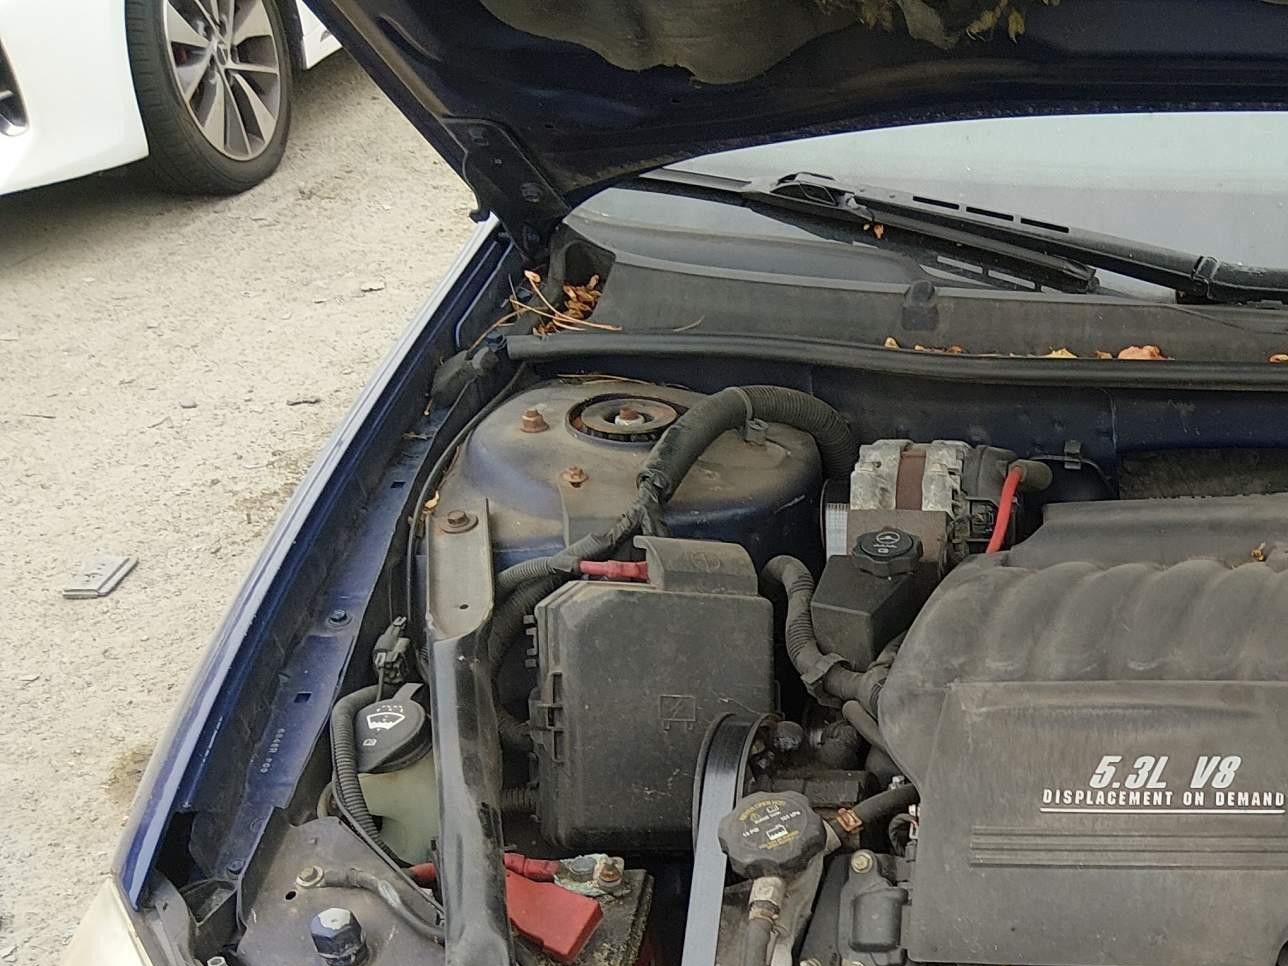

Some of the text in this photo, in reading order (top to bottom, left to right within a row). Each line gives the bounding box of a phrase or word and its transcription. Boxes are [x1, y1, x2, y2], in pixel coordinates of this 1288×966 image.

[1089, 755, 1242, 789] 5.3L V8
[1043, 789, 1286, 806] DISPLACEMENT ON DEMAND
